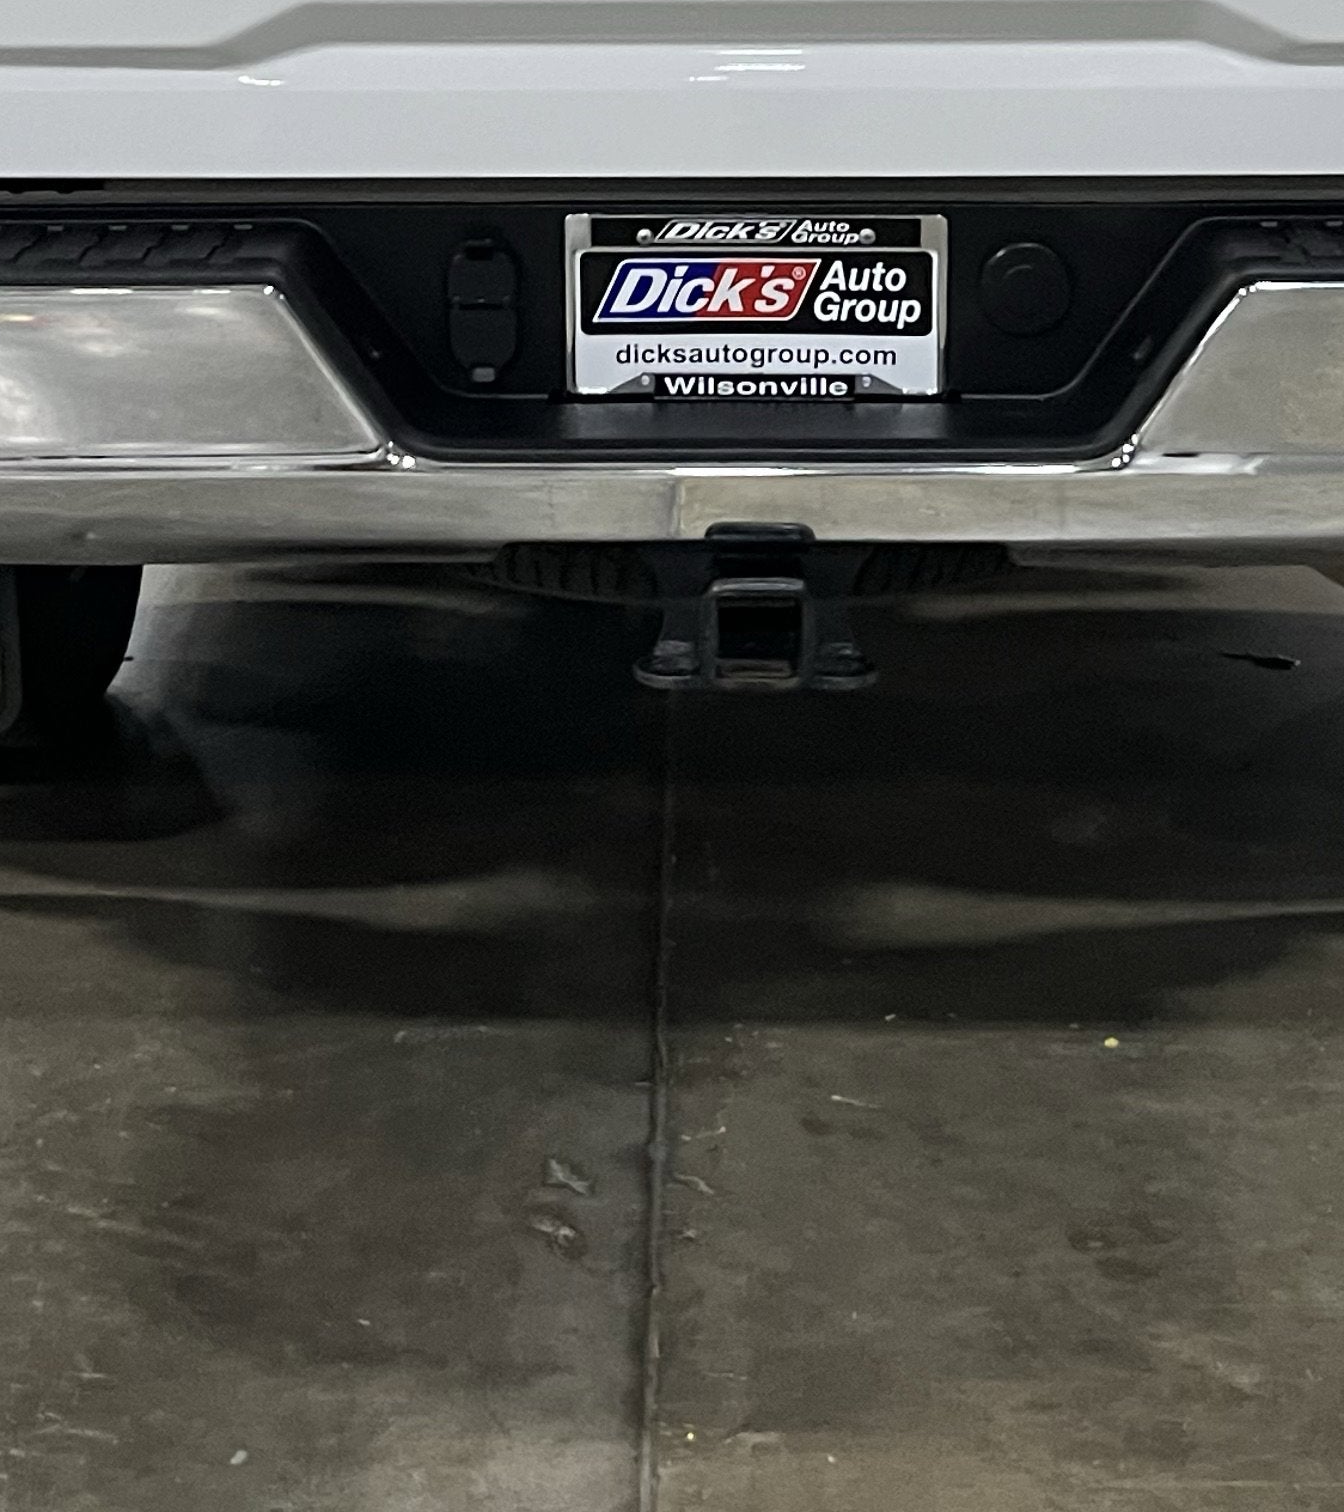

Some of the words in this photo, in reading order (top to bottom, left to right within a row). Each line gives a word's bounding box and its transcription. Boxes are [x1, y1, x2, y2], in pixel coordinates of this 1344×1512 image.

[663, 220, 786, 240] Dick's
[800, 220, 850, 233] Auto
[791, 231, 859, 245] Group
[608, 264, 798, 314] Dick's
[820, 260, 907, 292] Auto
[813, 292, 922, 329] Group
[616, 343, 898, 368] dicksautogroup.com
[663, 376, 849, 397] Wilsonville
